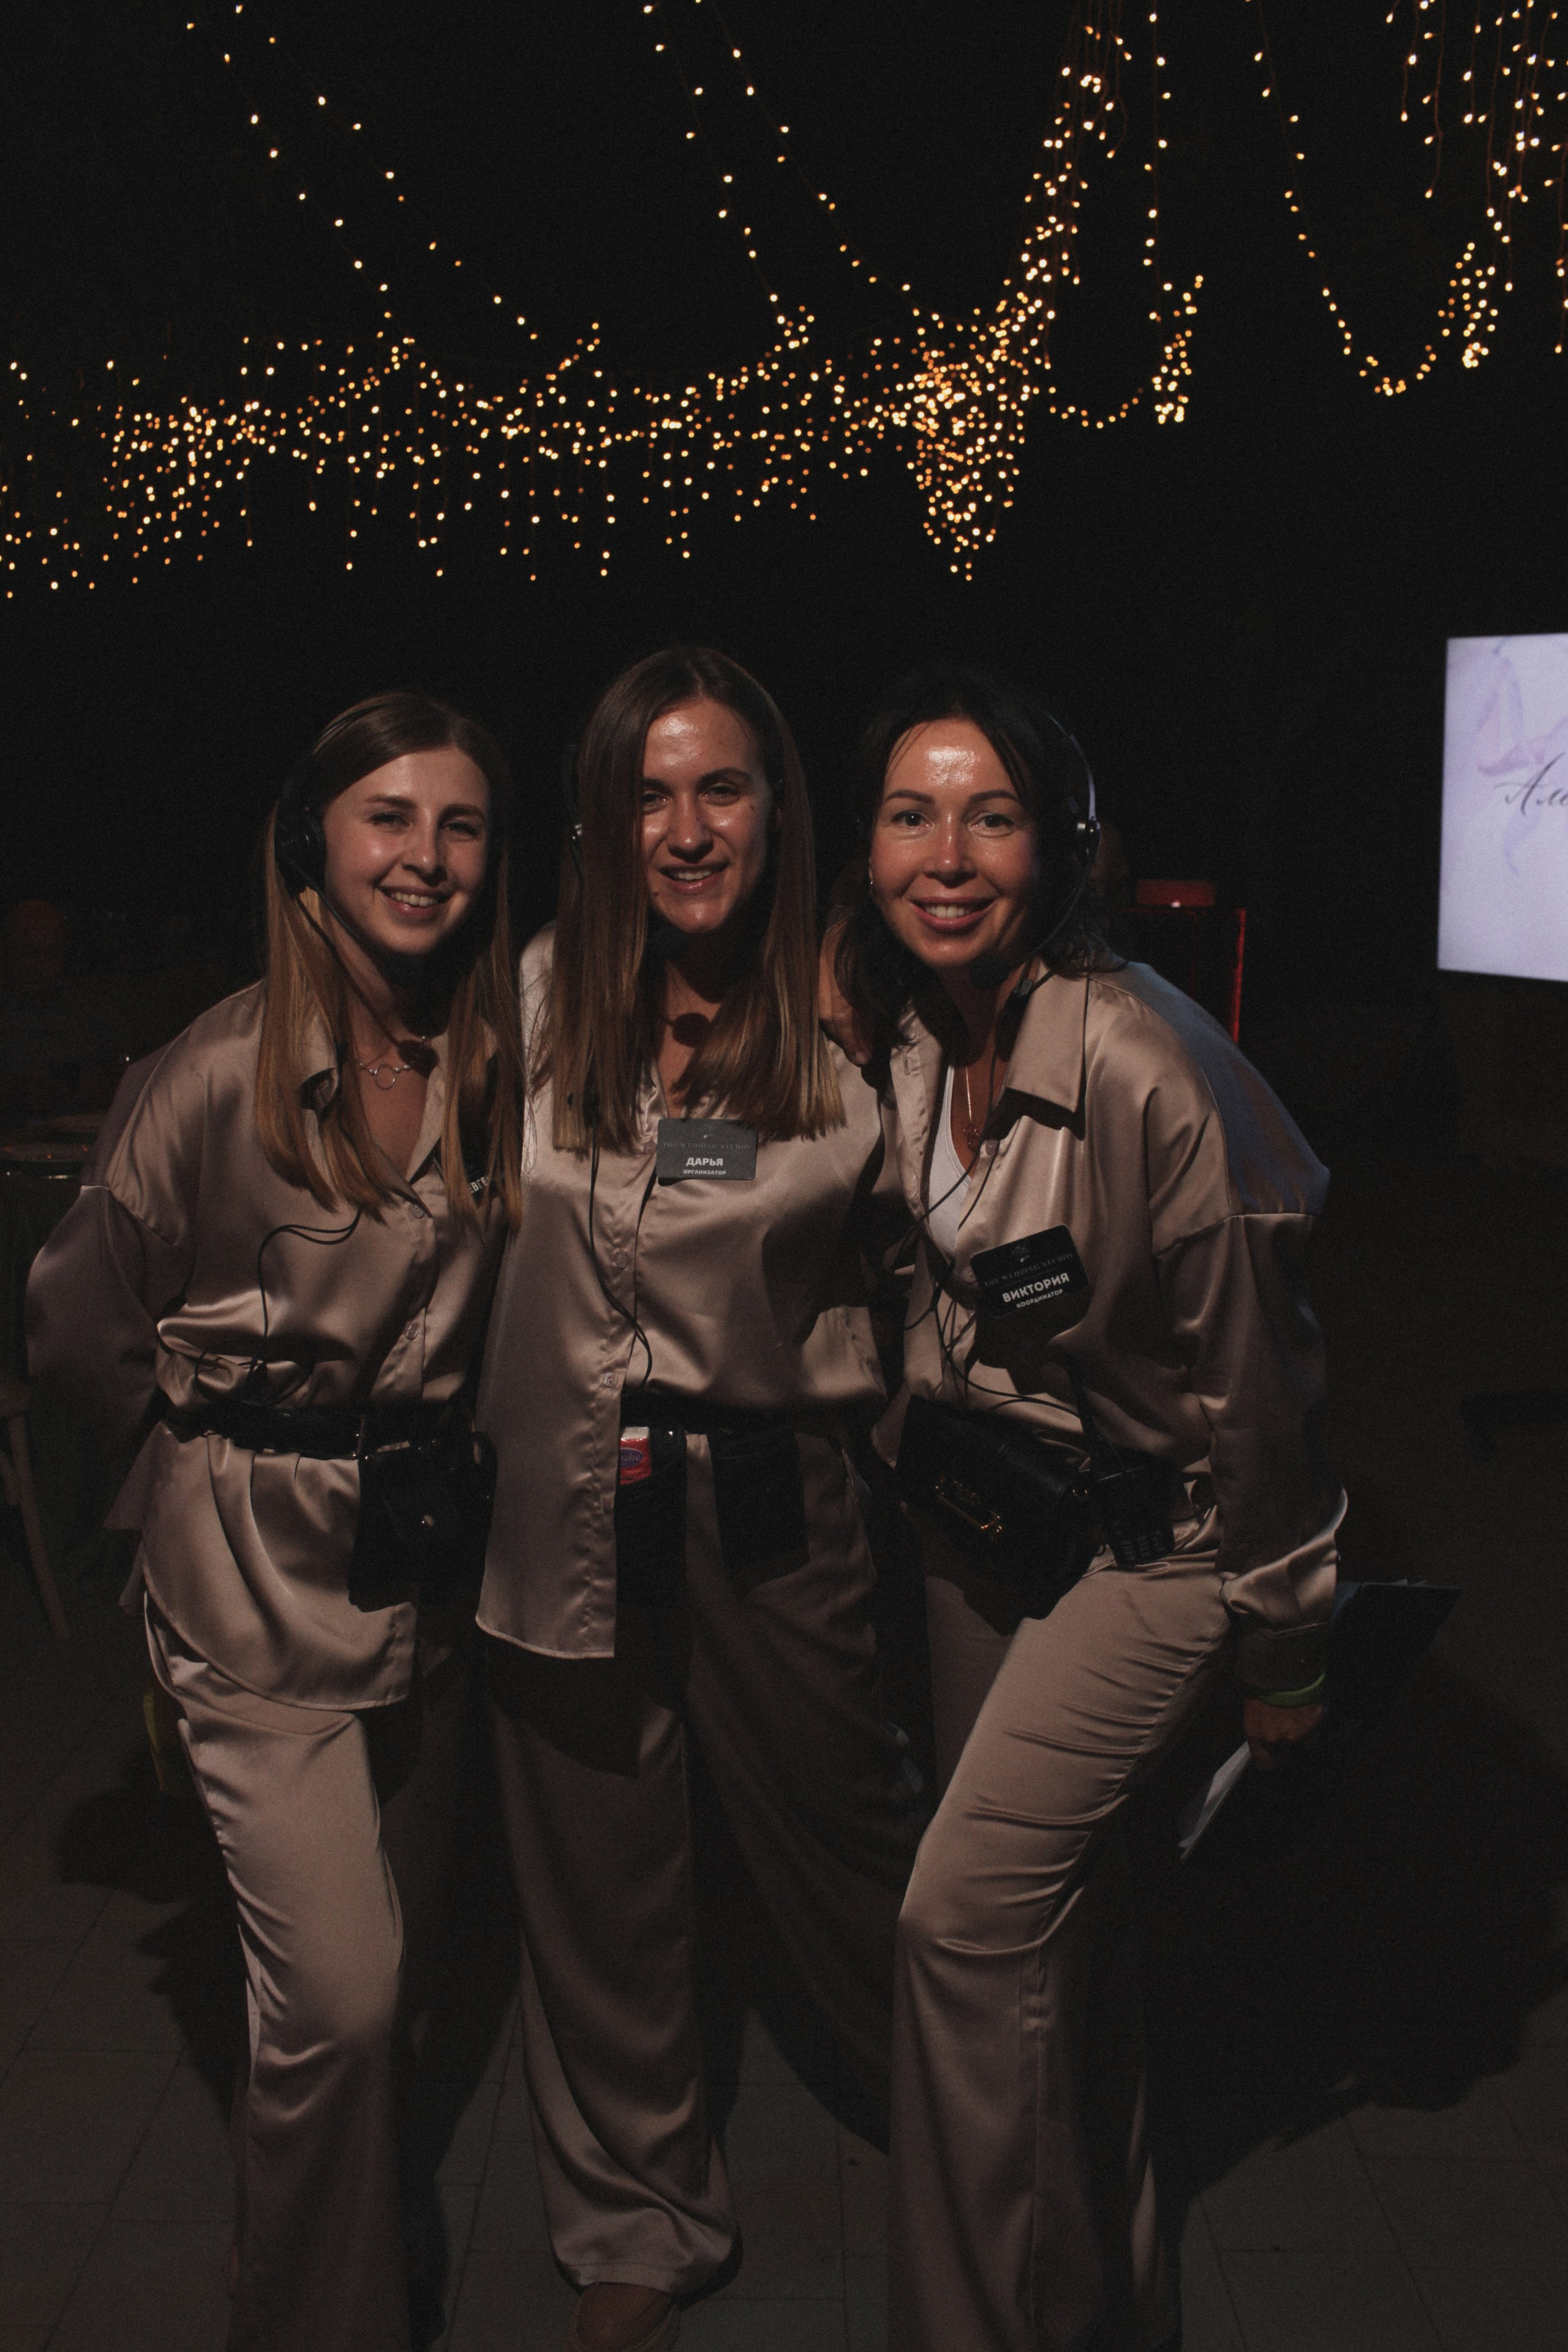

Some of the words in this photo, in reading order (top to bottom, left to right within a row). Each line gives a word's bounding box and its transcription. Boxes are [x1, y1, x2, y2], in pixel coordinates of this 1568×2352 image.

[685, 1157, 723, 1167] ДАРЬЯ
[1001, 1272, 1070, 1303] ВИКТОРИЯ
[1016, 1289, 1063, 1308] КООРДИНАТОР
